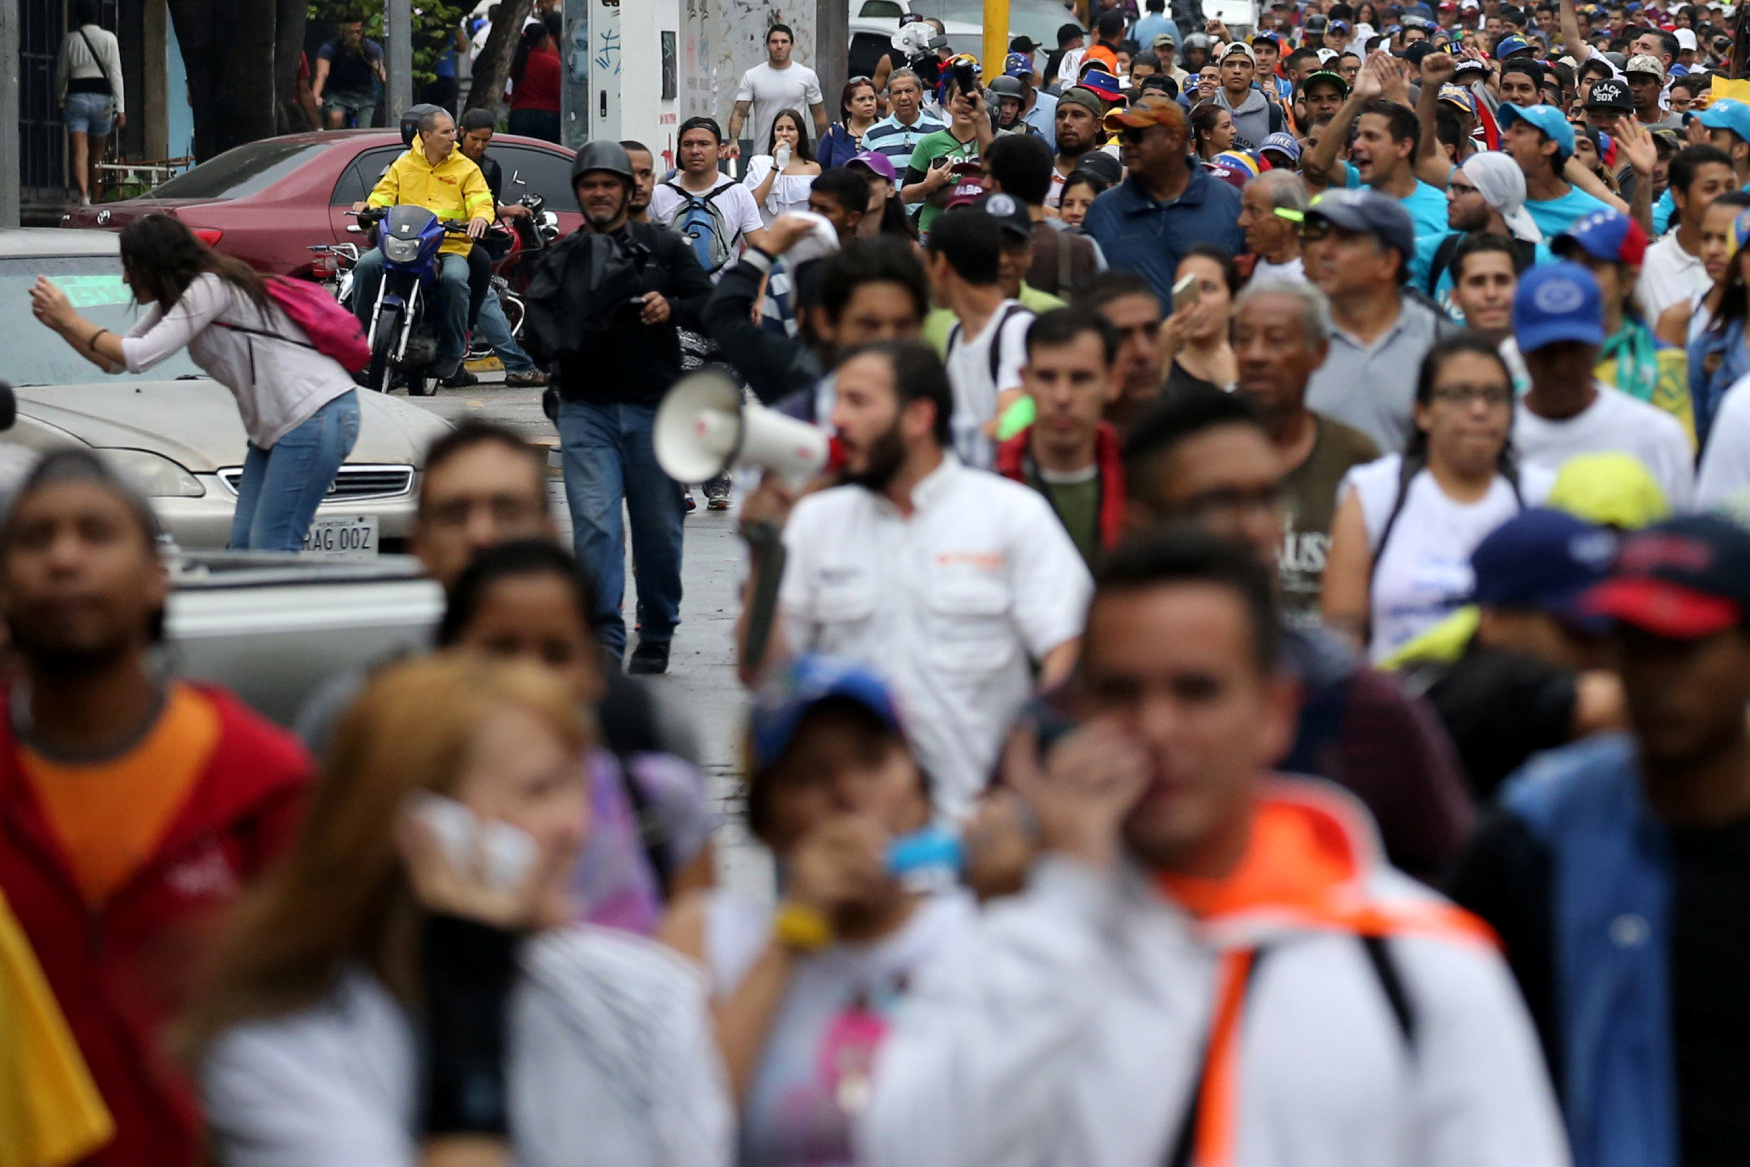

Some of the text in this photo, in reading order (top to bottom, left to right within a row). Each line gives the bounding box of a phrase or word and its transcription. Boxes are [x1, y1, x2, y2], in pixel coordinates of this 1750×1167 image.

[1592, 83, 1621, 98] BLACK
[1596, 93, 1613, 102] SOX
[1269, 134, 1292, 149] NIKE
